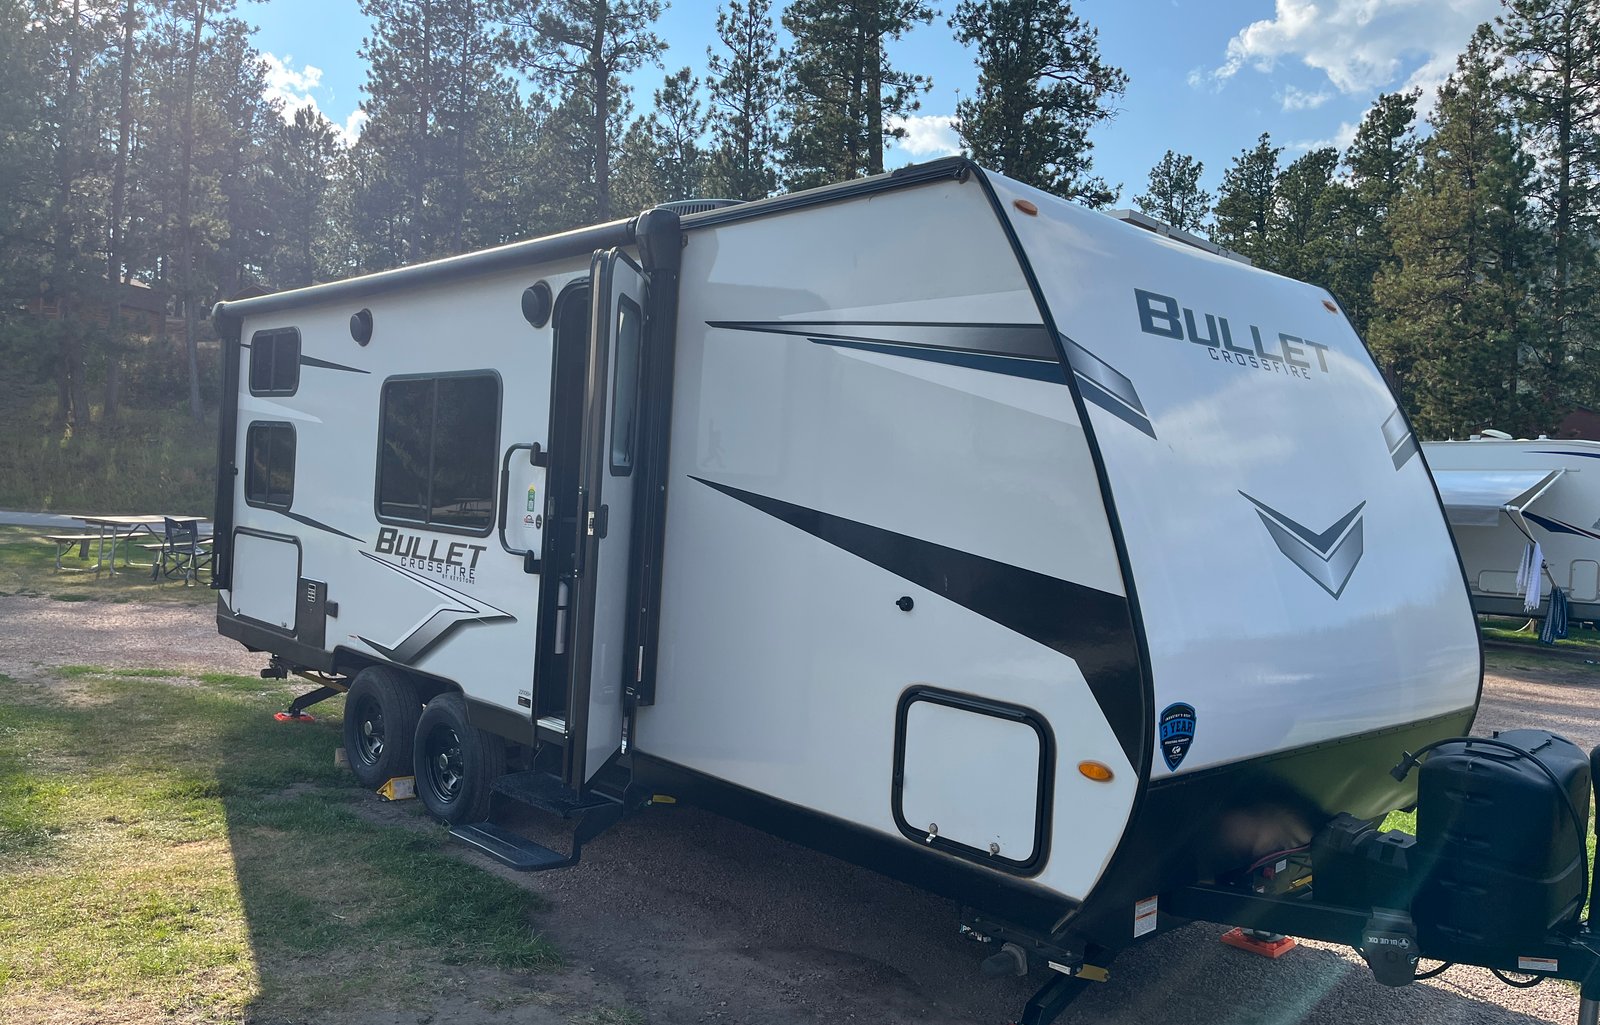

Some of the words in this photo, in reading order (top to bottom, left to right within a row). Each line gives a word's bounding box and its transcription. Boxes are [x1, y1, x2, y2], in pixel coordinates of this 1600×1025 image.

[1133, 287, 1329, 373] BULLET
[1207, 347, 1311, 380] CROSSFIRE
[374, 526, 487, 568] BULLET
[400, 556, 475, 580] CROSSFIRE
[1163, 725, 1168, 737] 3
[1170, 721, 1192, 733] YEAR
